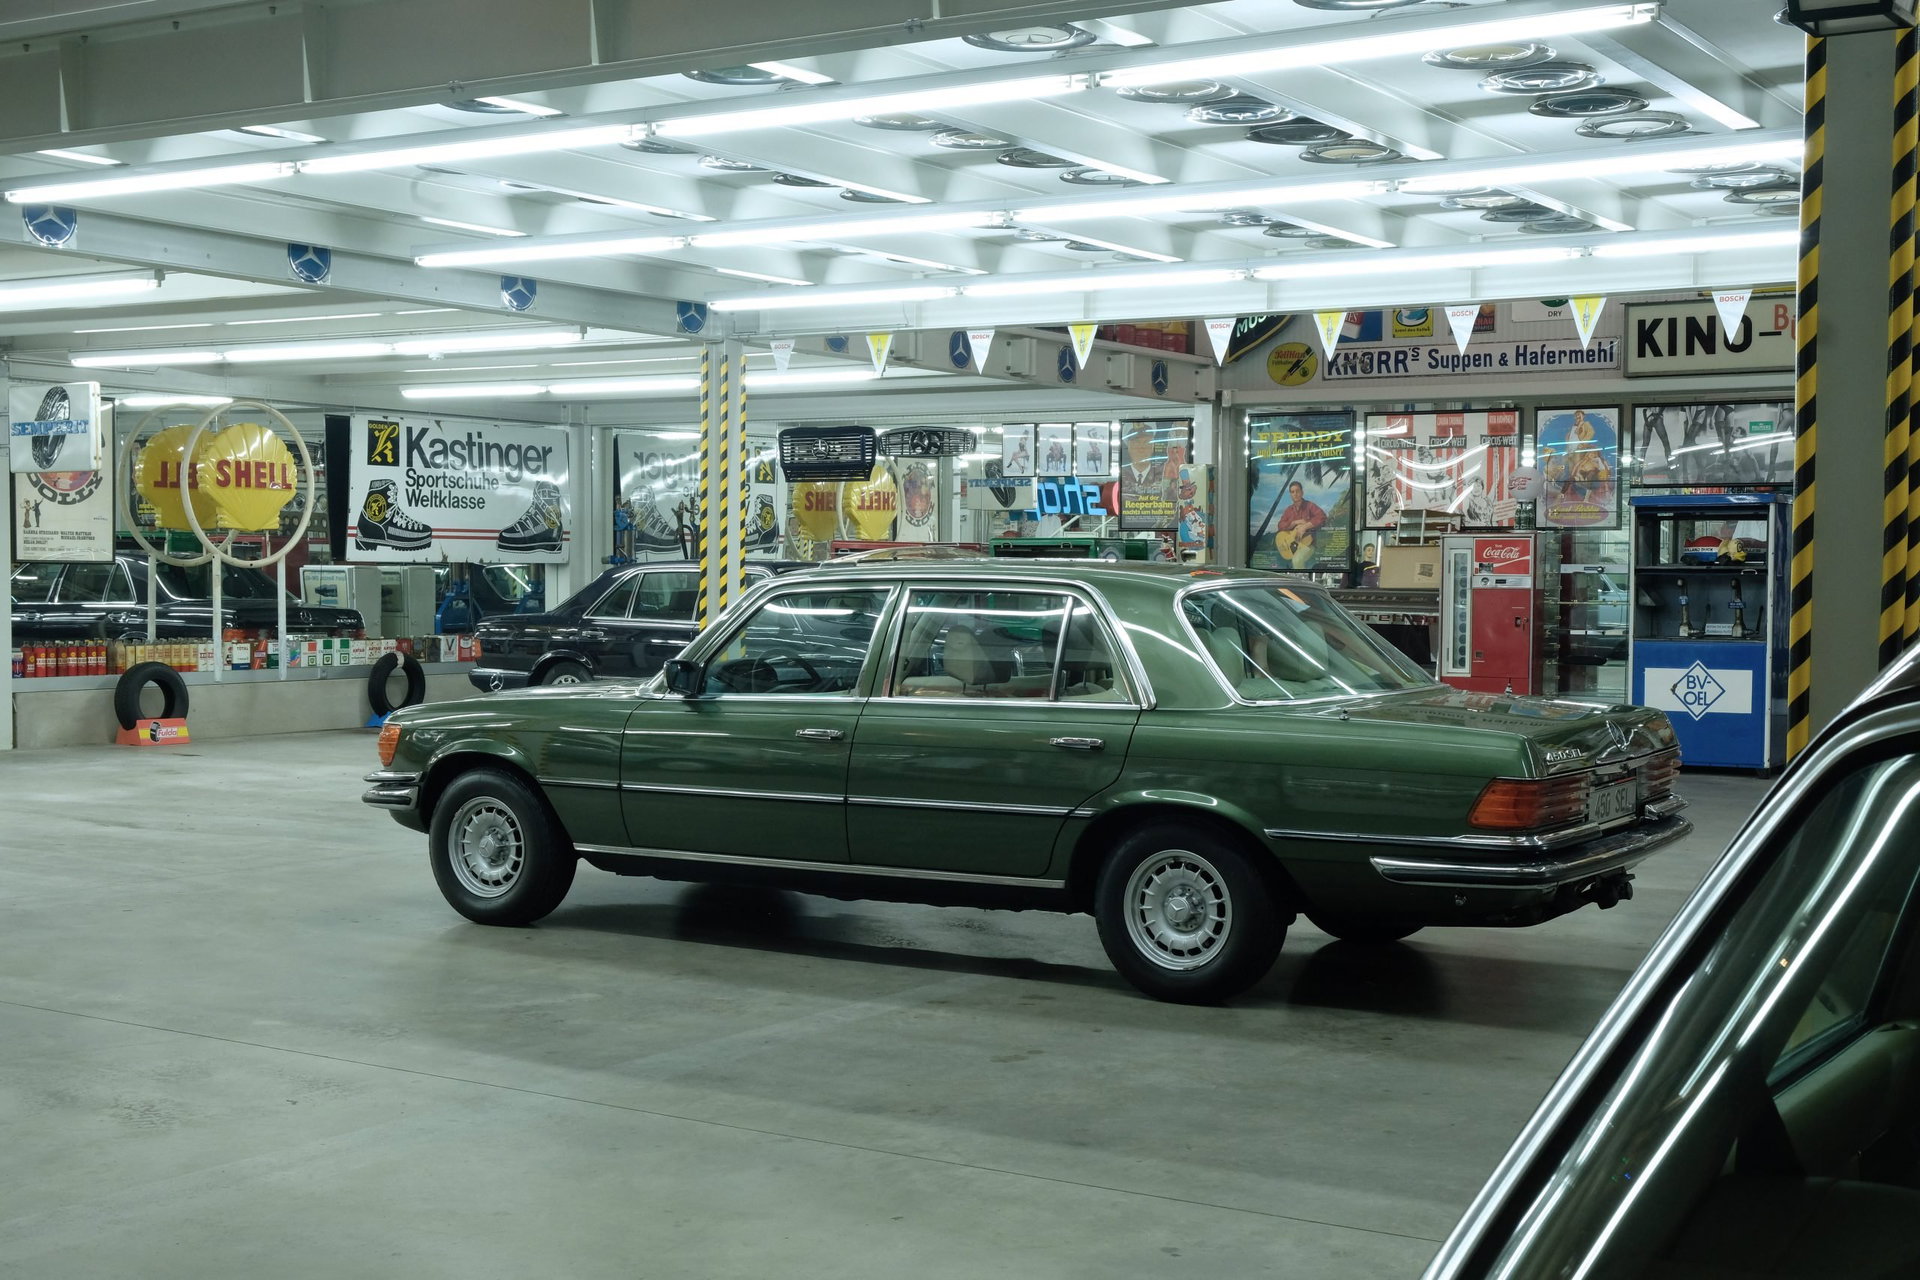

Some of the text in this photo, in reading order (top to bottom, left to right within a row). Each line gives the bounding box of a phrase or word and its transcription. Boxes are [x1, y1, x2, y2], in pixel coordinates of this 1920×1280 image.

[1719, 294, 1745, 303] BOSCH
[1451, 310, 1474, 318] BOSCH
[1547, 310, 1562, 318] DRY
[1210, 322, 1231, 330] BOSCH
[1428, 347, 1493, 373] Suppen
[1498, 351, 1509, 366] &
[1515, 341, 1615, 367] Hafermehl
[11, 420, 89, 437] SEMPERIT
[1257, 431, 1344, 443] FREDDY
[406, 426, 553, 483] Kastinger
[215, 459, 293, 490] SHELL
[405, 468, 499, 492] Sportschuhe
[405, 488, 486, 510] Weltklasse
[1125, 500, 1173, 510] Reeperbahn
[1683, 691, 1710, 707] OEL
[157, 728, 177, 737] Fulda
